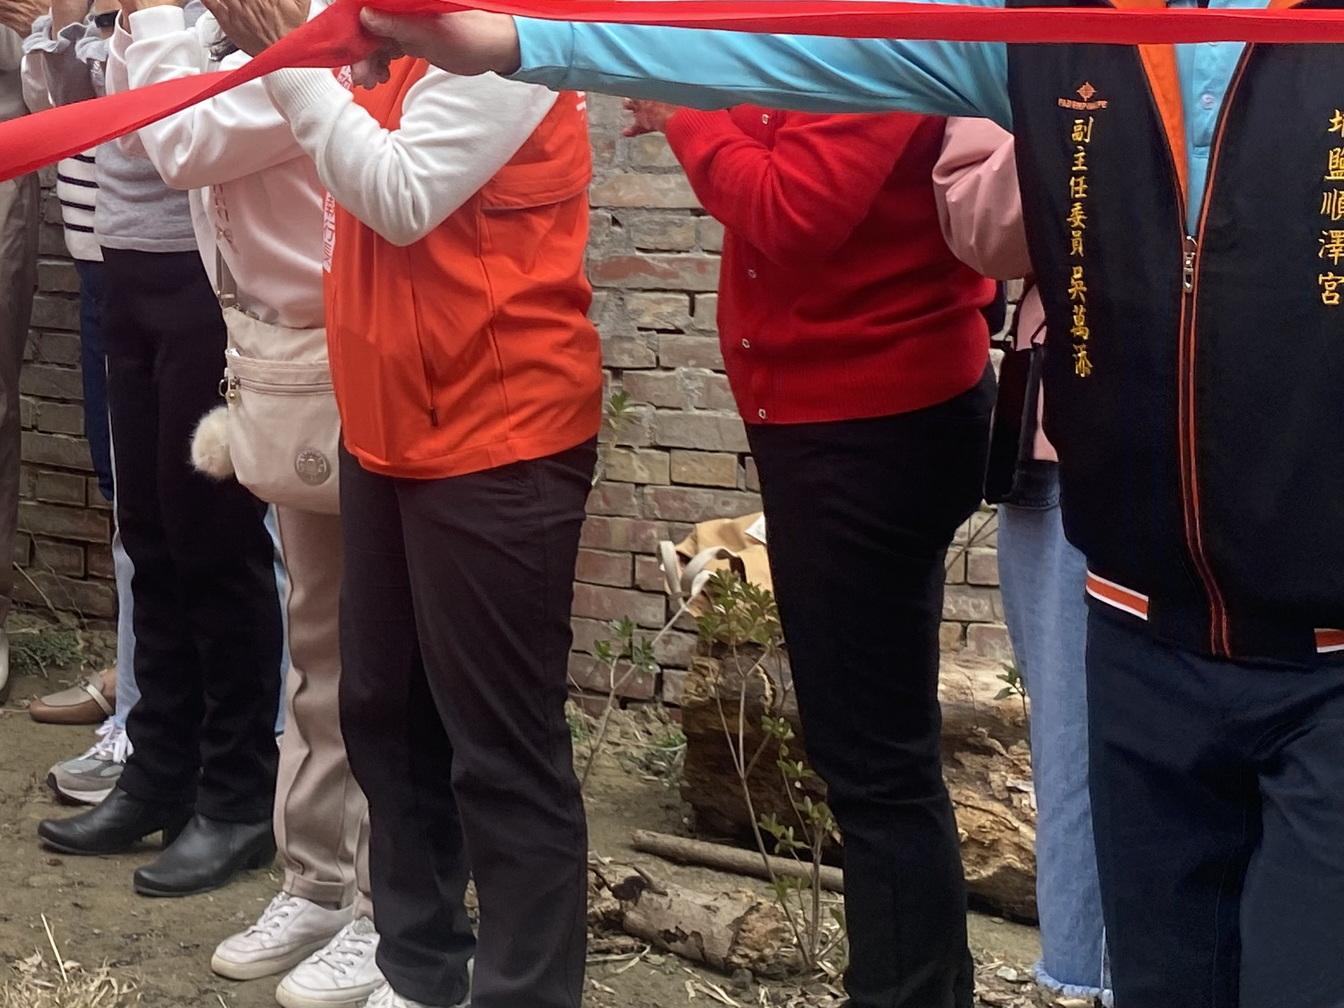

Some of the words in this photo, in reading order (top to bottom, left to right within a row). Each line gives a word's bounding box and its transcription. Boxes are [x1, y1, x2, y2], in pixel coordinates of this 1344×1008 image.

[1066, 116, 1095, 258] 副主任委員
